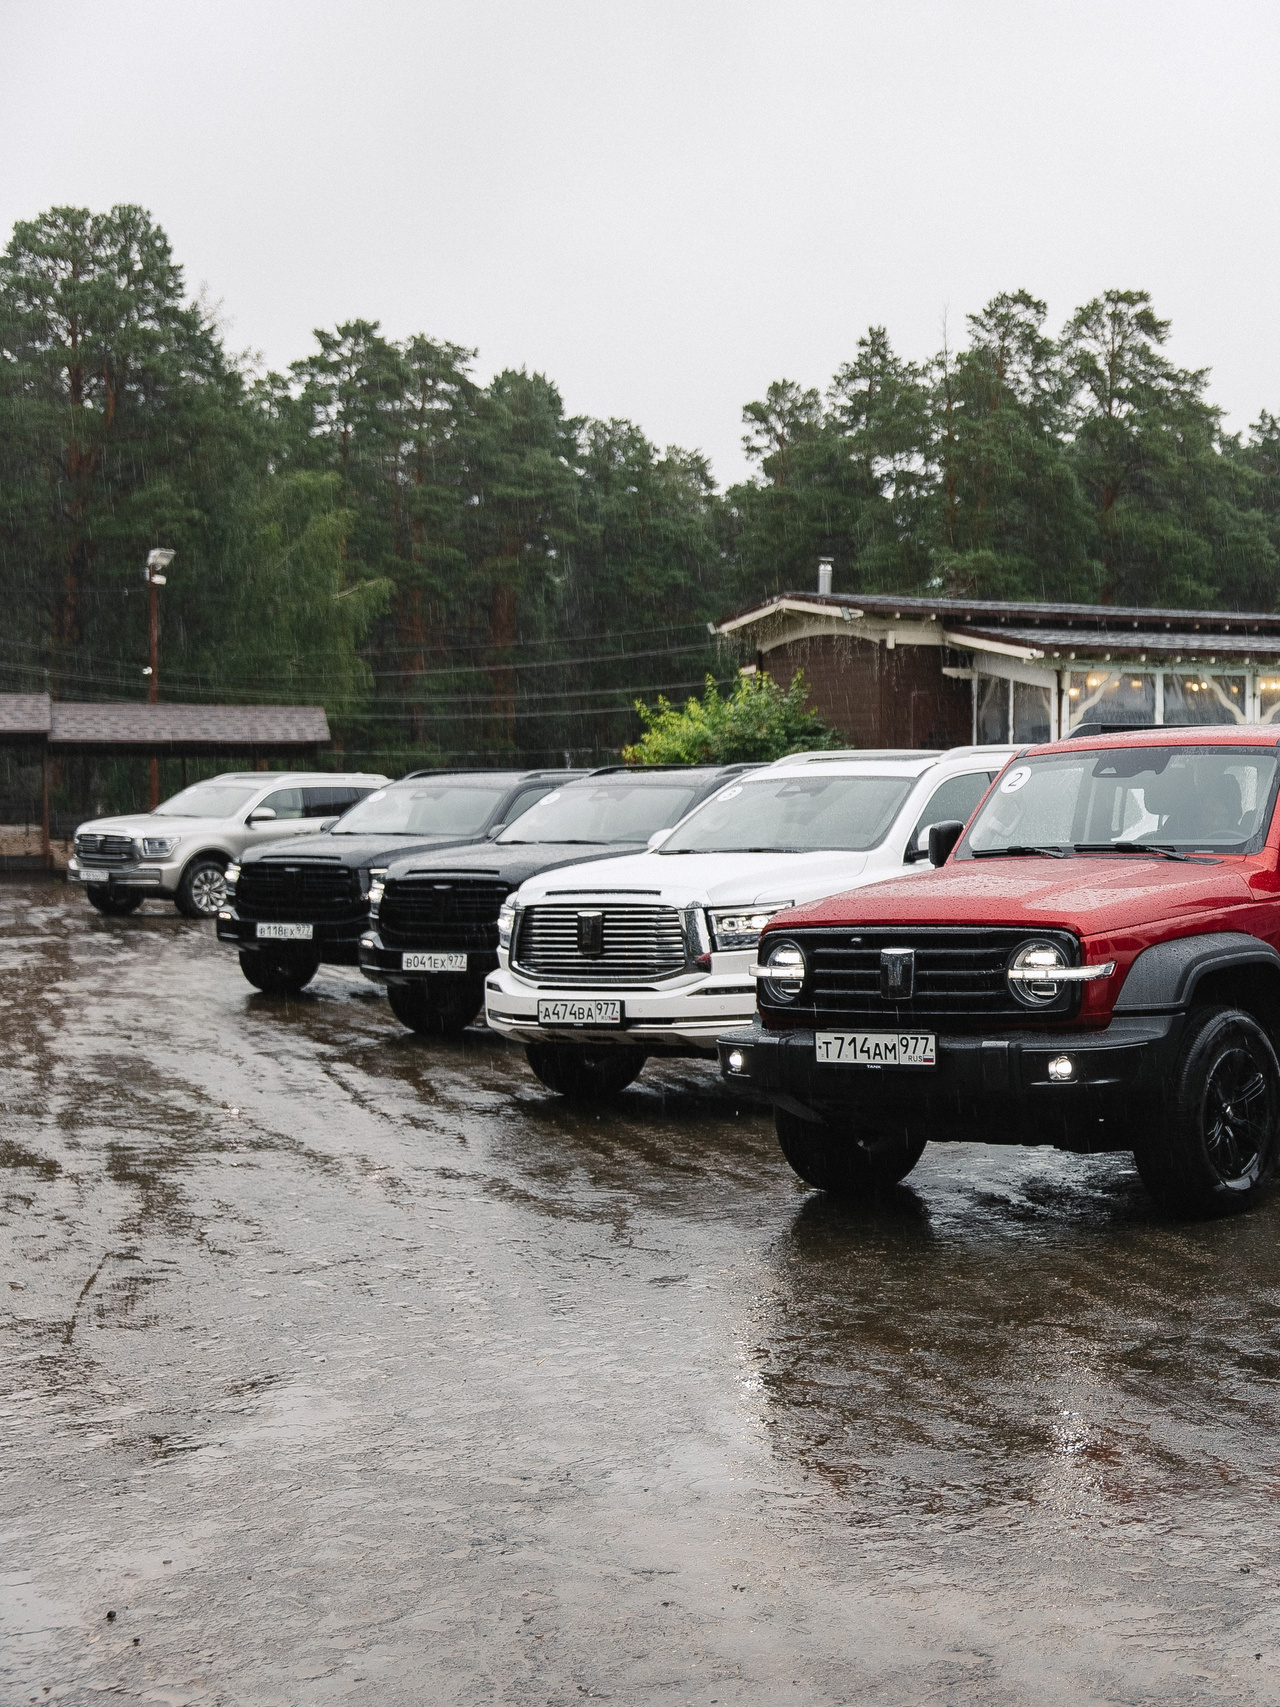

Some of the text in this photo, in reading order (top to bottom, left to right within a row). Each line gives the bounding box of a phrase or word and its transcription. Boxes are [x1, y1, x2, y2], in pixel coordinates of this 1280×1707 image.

[1007, 772, 1023, 788] 2
[406, 955, 464, 969] В041ЕХ 977
[543, 1002, 617, 1020] А474ВА 977
[822, 1036, 930, 1061] Т714АМ 977
[908, 1055, 922, 1063] RUS
